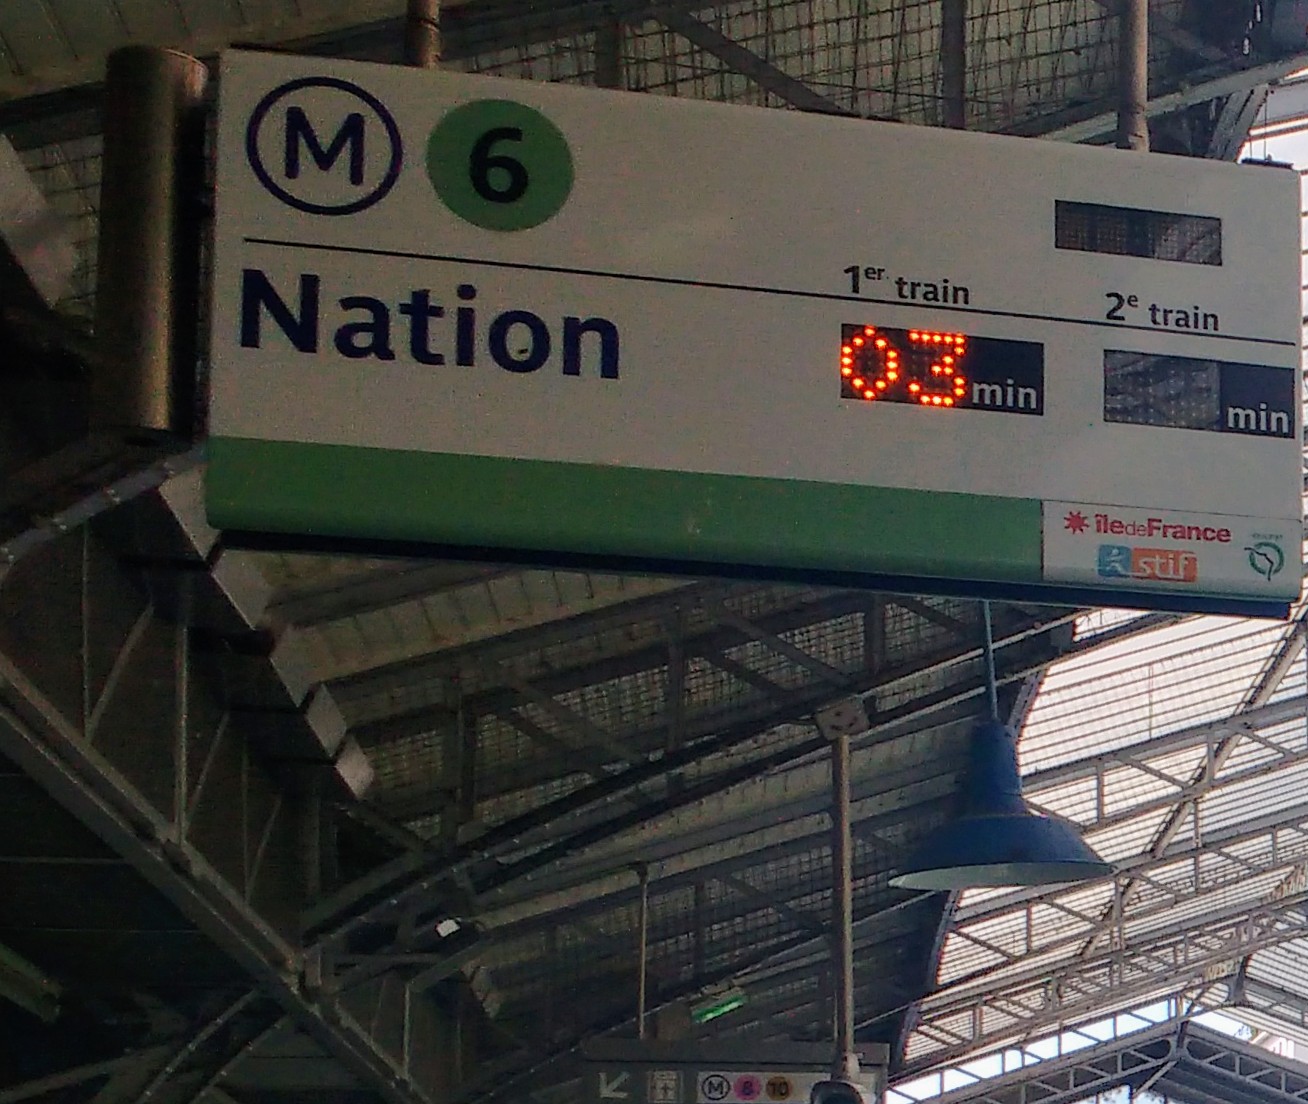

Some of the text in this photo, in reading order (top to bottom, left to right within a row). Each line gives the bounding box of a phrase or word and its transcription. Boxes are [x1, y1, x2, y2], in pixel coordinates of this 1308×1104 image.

[284, 105, 530, 204] M 6
[895, 276, 970, 305] train
[239, 267, 621, 380] Nation
[1105, 291, 1220, 332] 2e train
[840, 325, 1038, 410] 03 min
[1226, 402, 1290, 435] min
[1137, 551, 1197, 580] stif
[767, 1080, 789, 1096] 10
